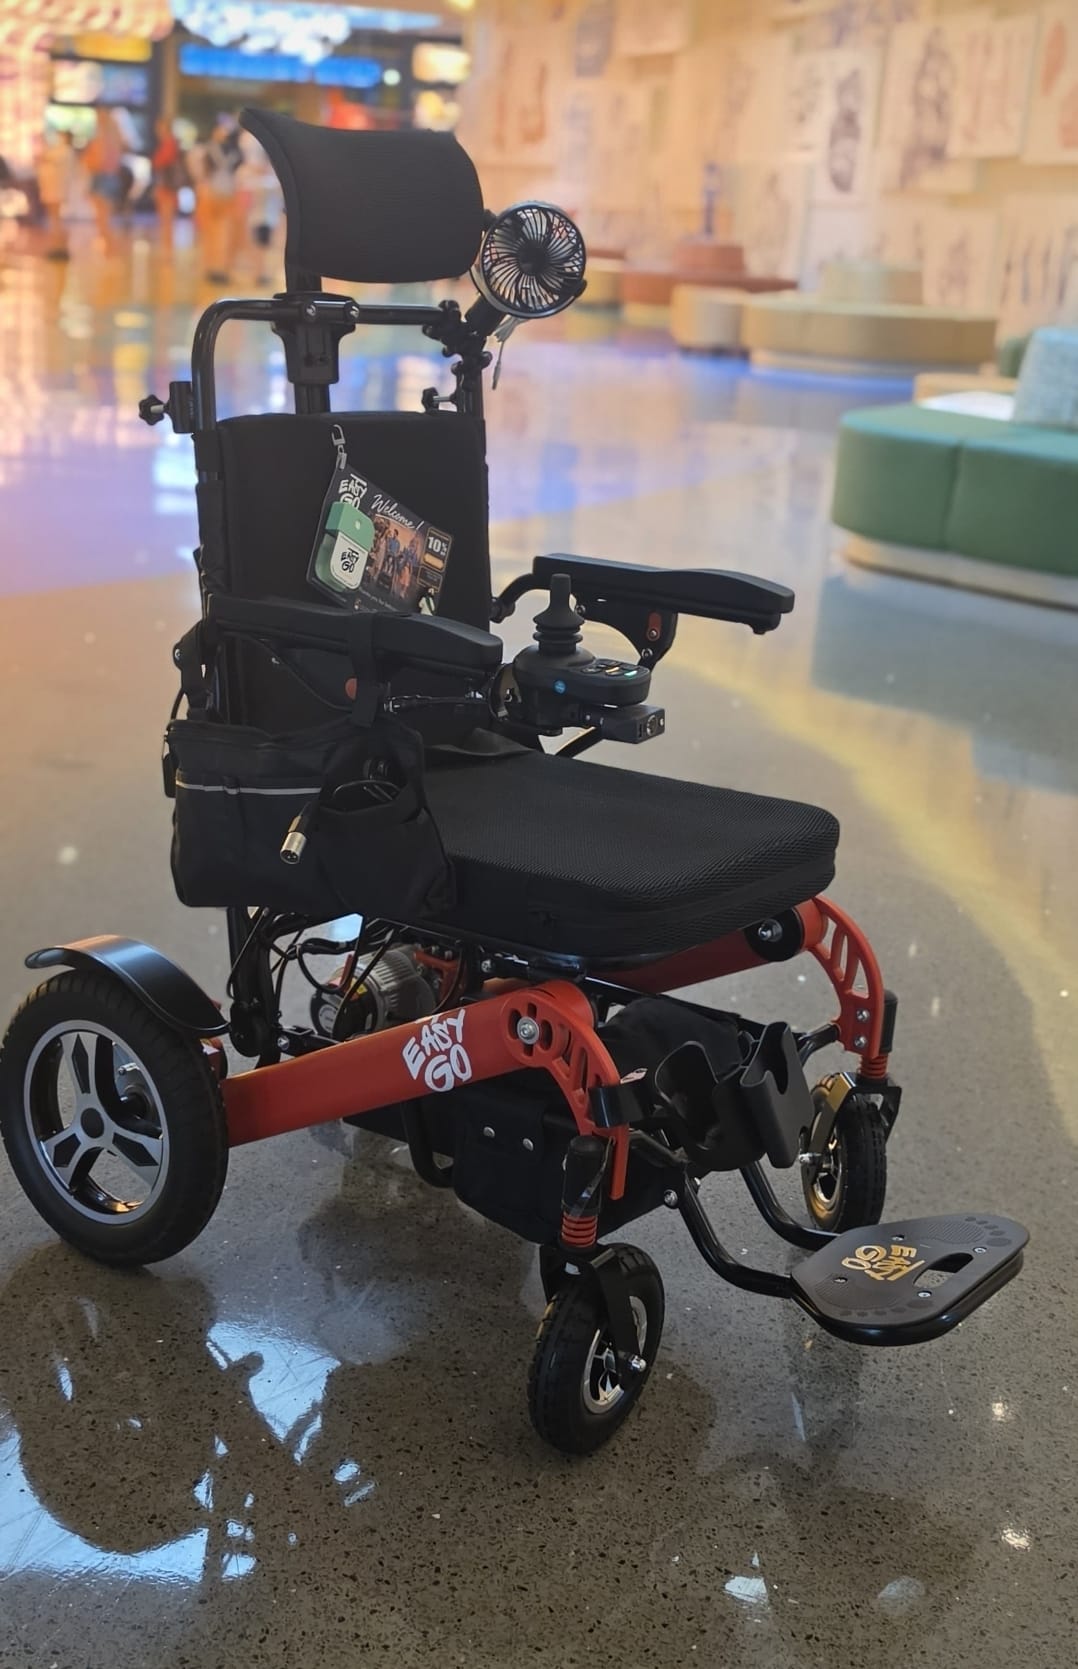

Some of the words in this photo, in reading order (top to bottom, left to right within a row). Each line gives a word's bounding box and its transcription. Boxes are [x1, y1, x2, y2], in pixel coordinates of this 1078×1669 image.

[338, 473, 368, 499] EASY
[340, 547, 360, 564] EASY
[341, 560, 355, 574] GO
[402, 1008, 466, 1080] EASY
[424, 1043, 473, 1092] GO
[841, 1245, 887, 1271] GO
[864, 1244, 926, 1281] EASY
